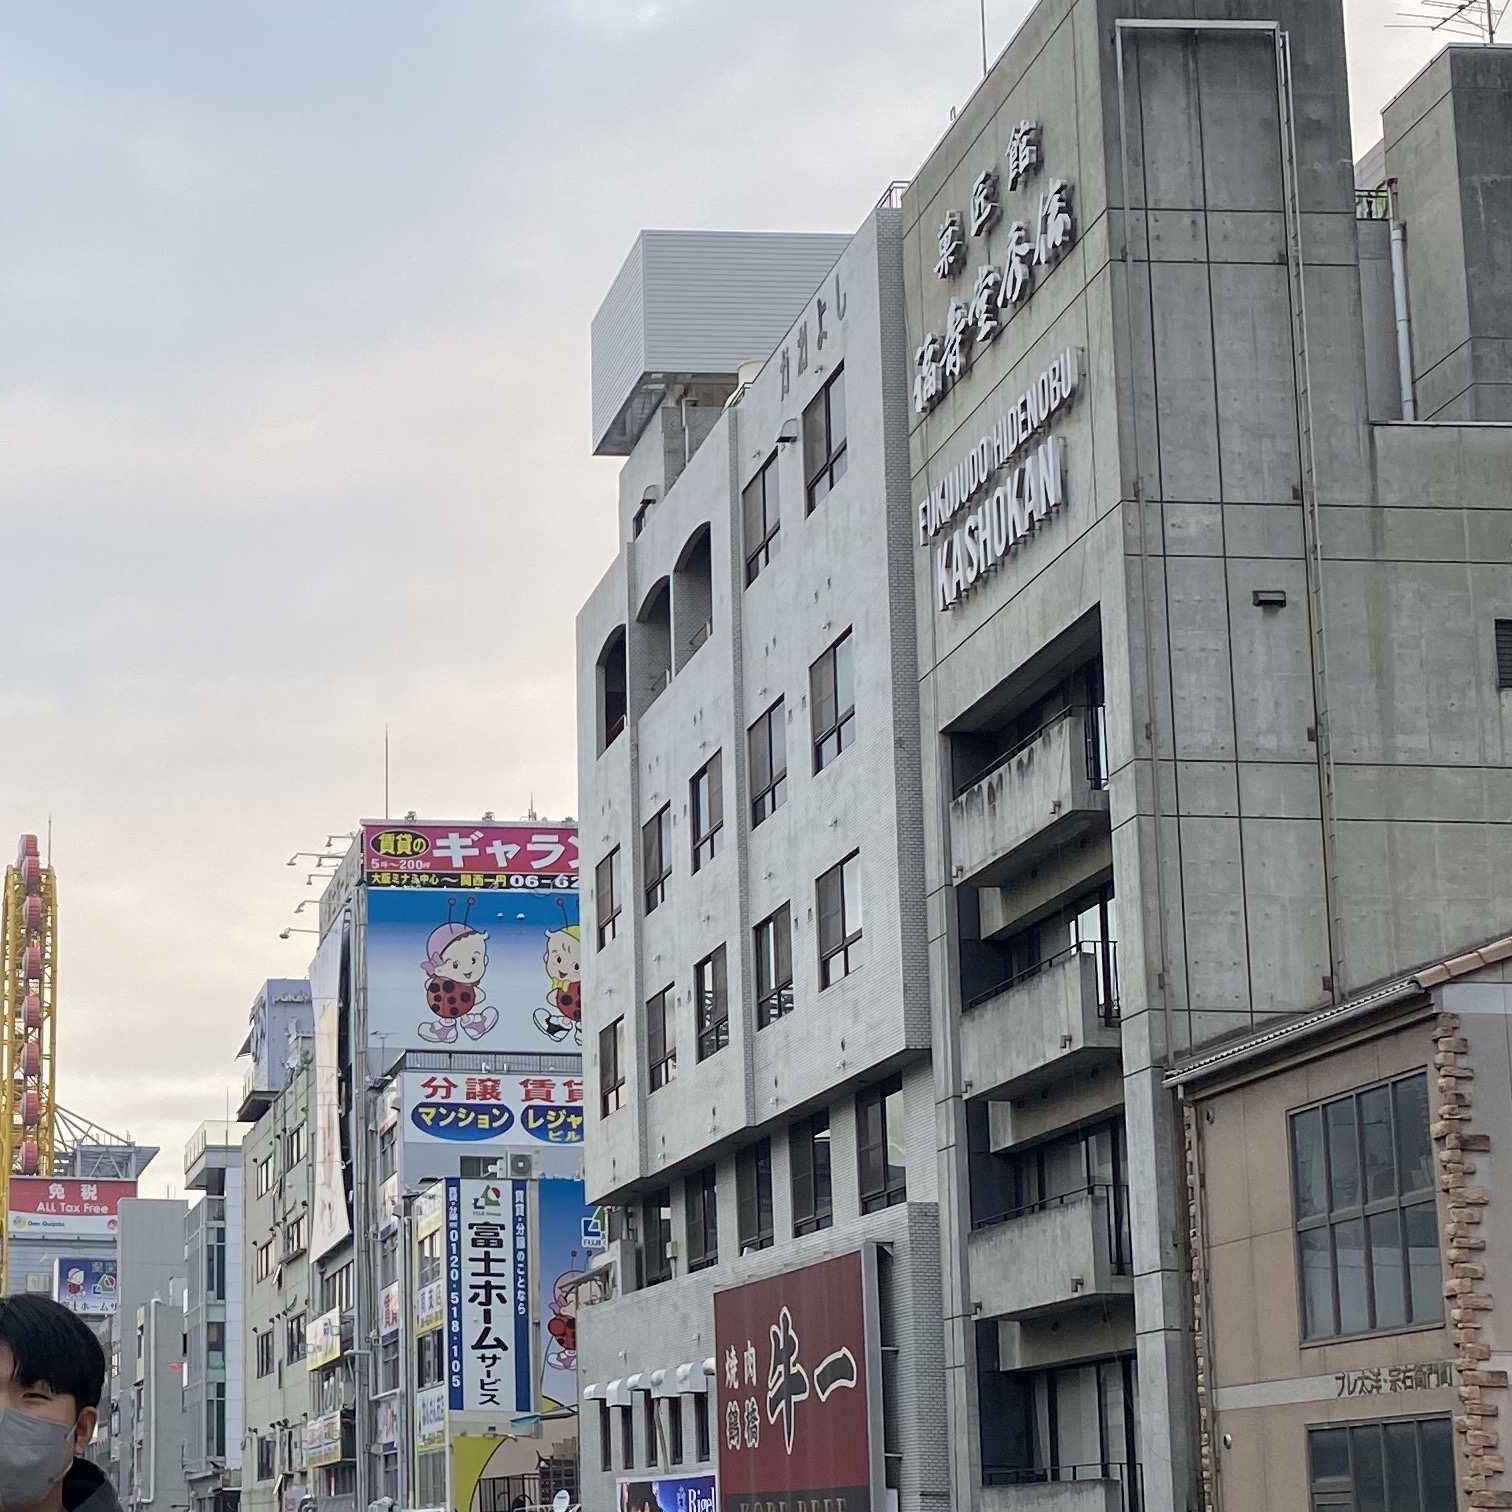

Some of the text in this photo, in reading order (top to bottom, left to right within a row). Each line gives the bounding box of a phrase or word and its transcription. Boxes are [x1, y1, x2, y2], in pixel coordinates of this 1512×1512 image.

[933, 118, 1041, 279] 菓匠館
[918, 346, 1083, 546] FUKUJUDO HIDENOBU
[935, 436, 1064, 611] KASHOKAN
[378, 833, 427, 855] 賃貸の
[420, 1076, 502, 1102] 分譲
[418, 1107, 510, 1129] マンション
[548, 1130, 580, 1142] ビル
[48, 1182, 98, 1201] 免税
[36, 1202, 109, 1215] ALL Tax Free
[725, 1305, 857, 1455] 焼肉 牛一
